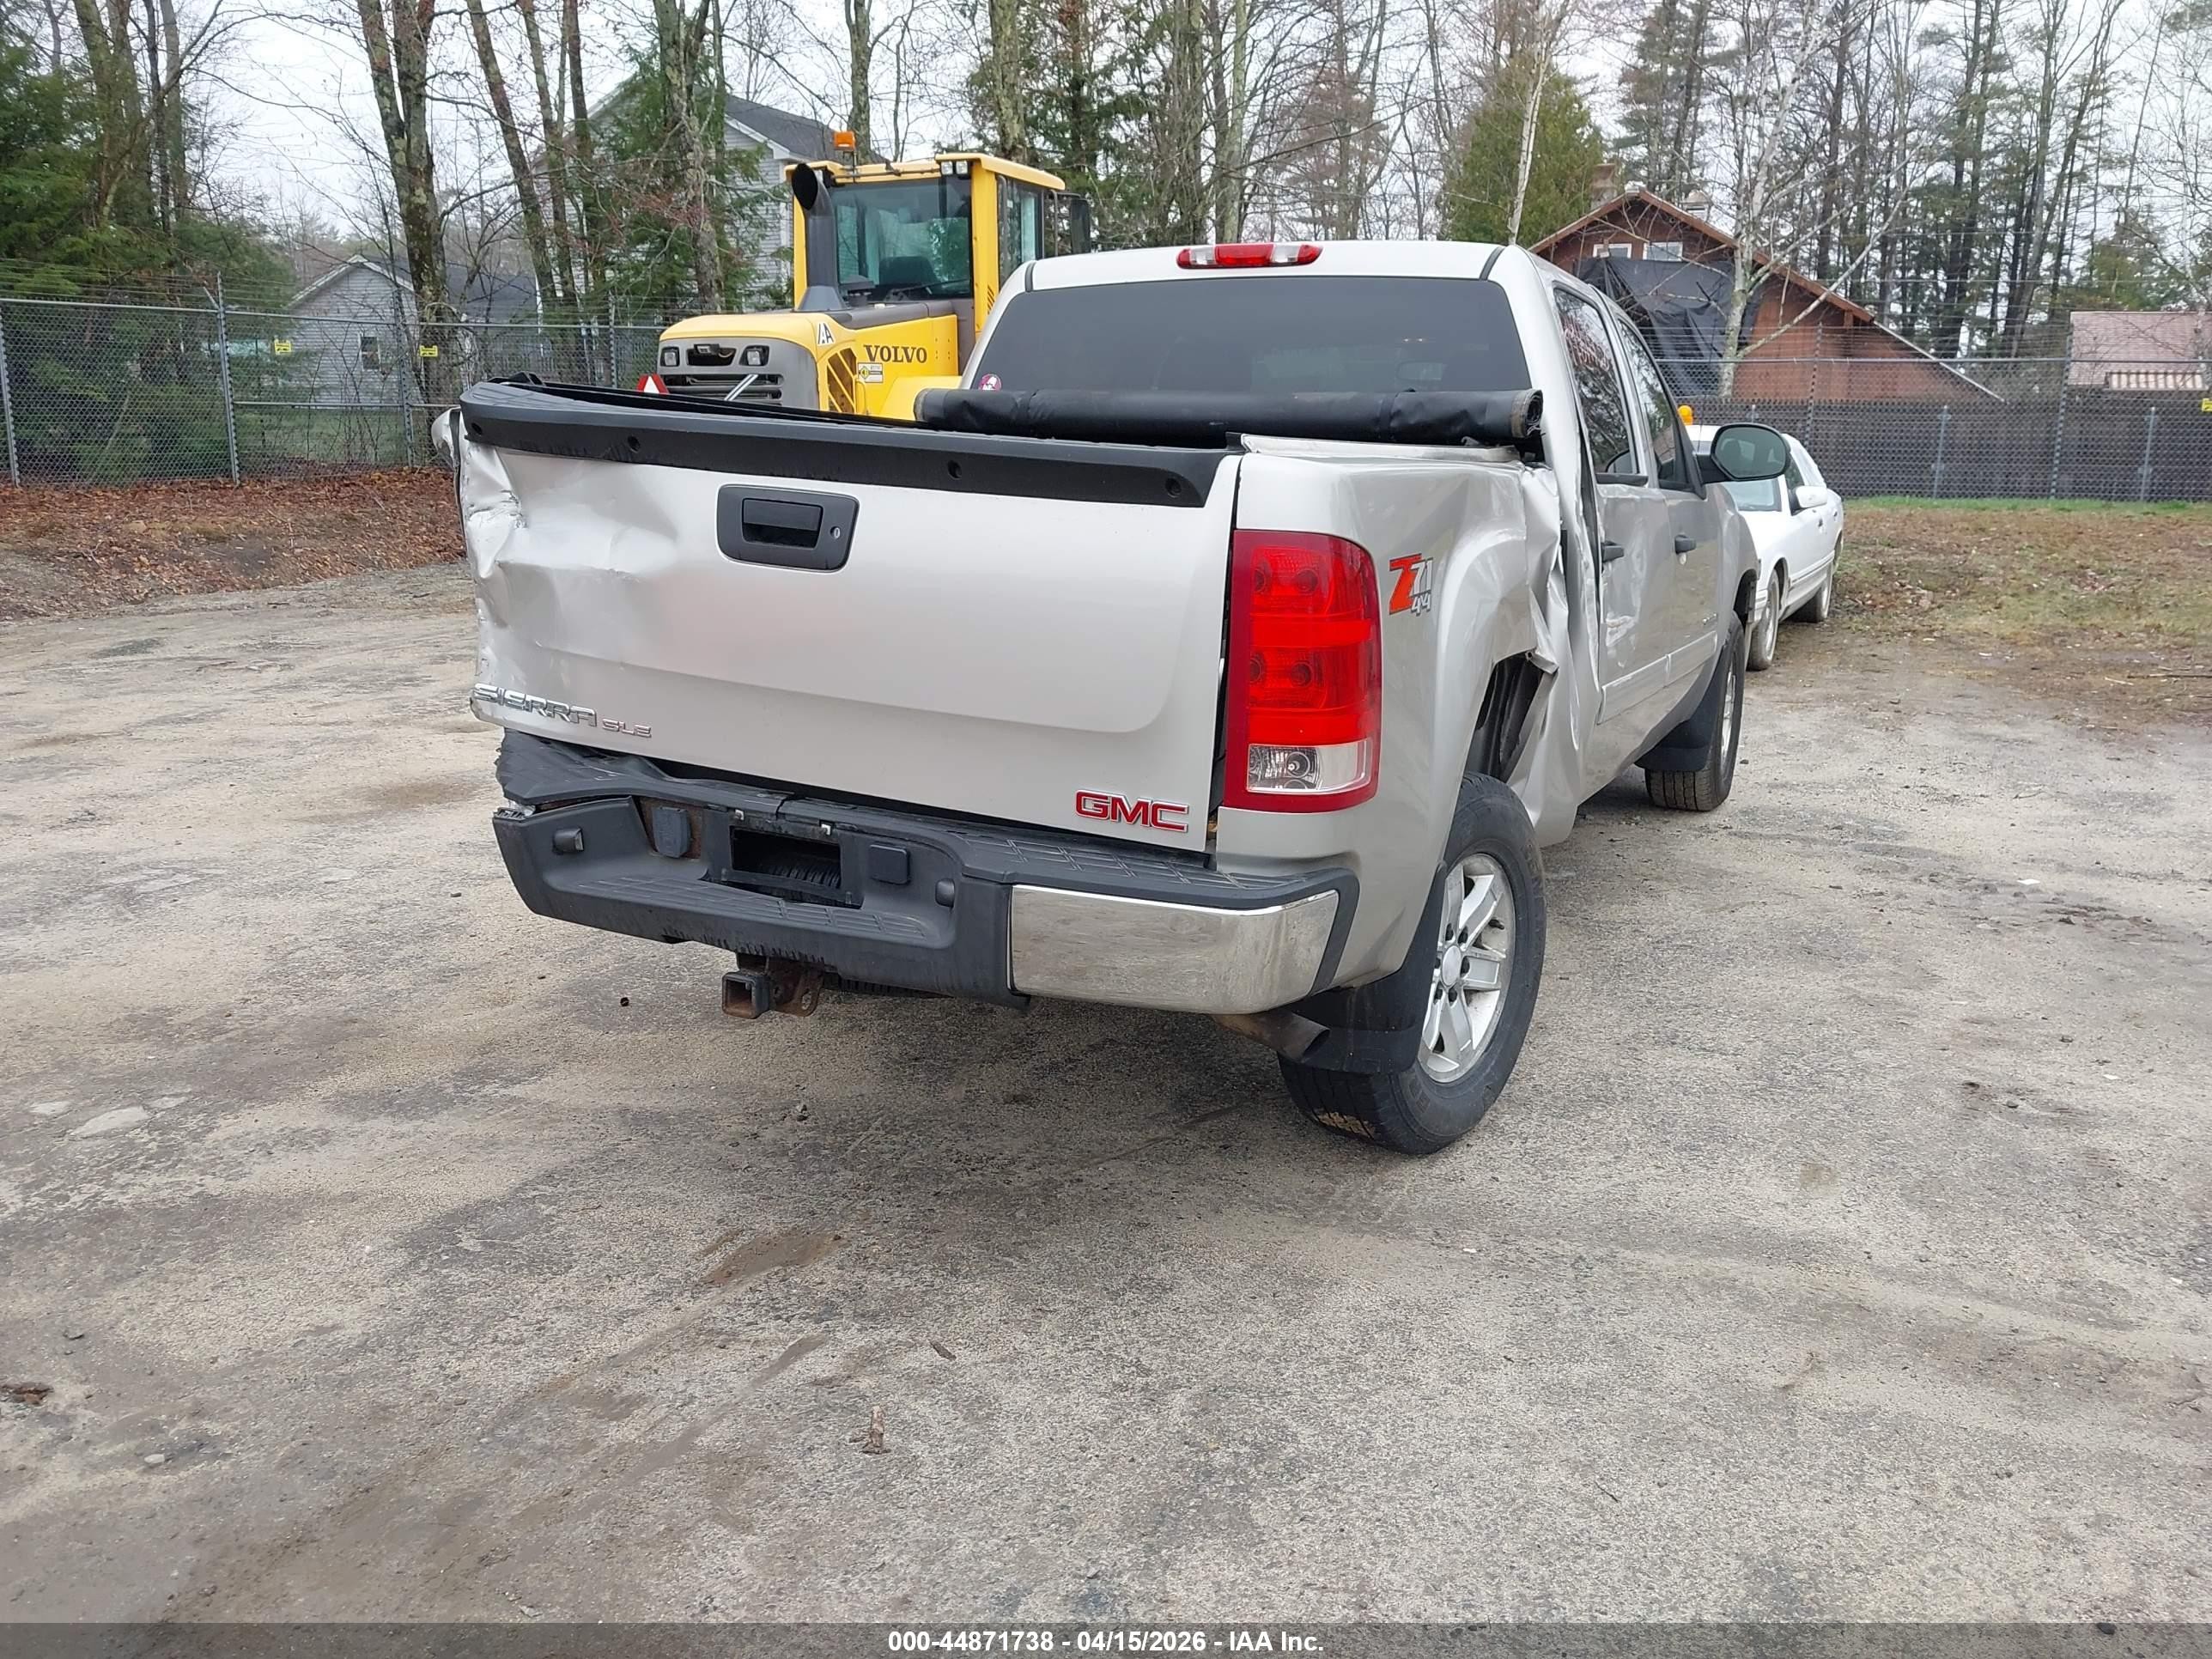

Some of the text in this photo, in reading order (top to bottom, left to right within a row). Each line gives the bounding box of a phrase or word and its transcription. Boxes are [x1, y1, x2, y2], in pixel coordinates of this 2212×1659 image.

[863, 345, 927, 363] VOLVO
[1389, 553, 1433, 616] Z71
[473, 683, 652, 738] SIERRA SLE
[1075, 789, 1189, 833] GMC
